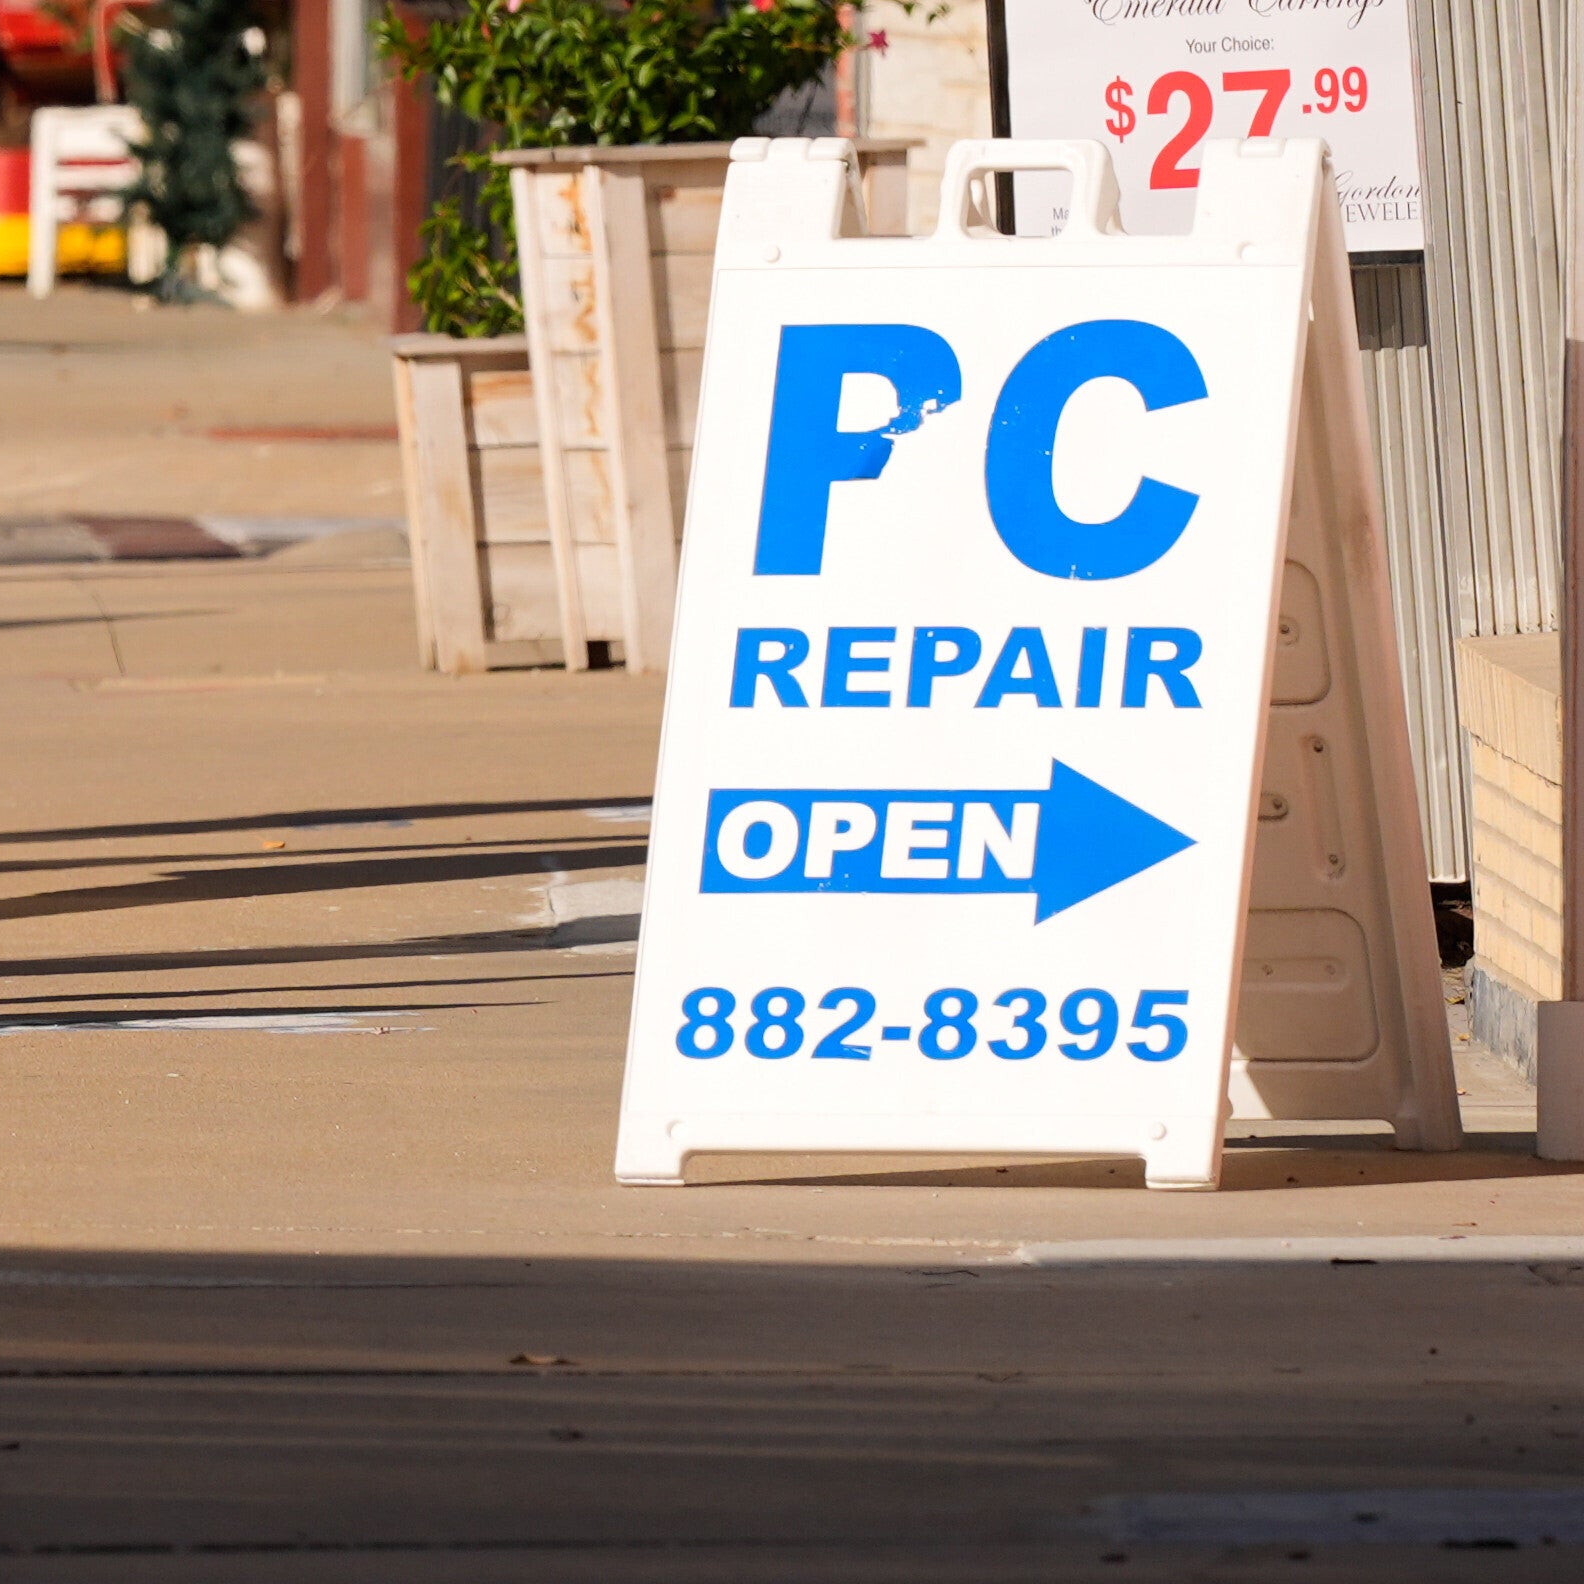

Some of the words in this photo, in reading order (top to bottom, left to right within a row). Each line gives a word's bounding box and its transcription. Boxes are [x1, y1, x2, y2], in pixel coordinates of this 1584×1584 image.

[1185, 38, 1217, 54] Your
[1221, 36, 1275, 53] Choice:
[1346, 201, 1419, 223] EWELE
[752, 319, 1209, 581] PC
[729, 626, 1203, 709] REPAIR
[715, 799, 1040, 881] OPEN
[674, 986, 1190, 1061] 882-8395
